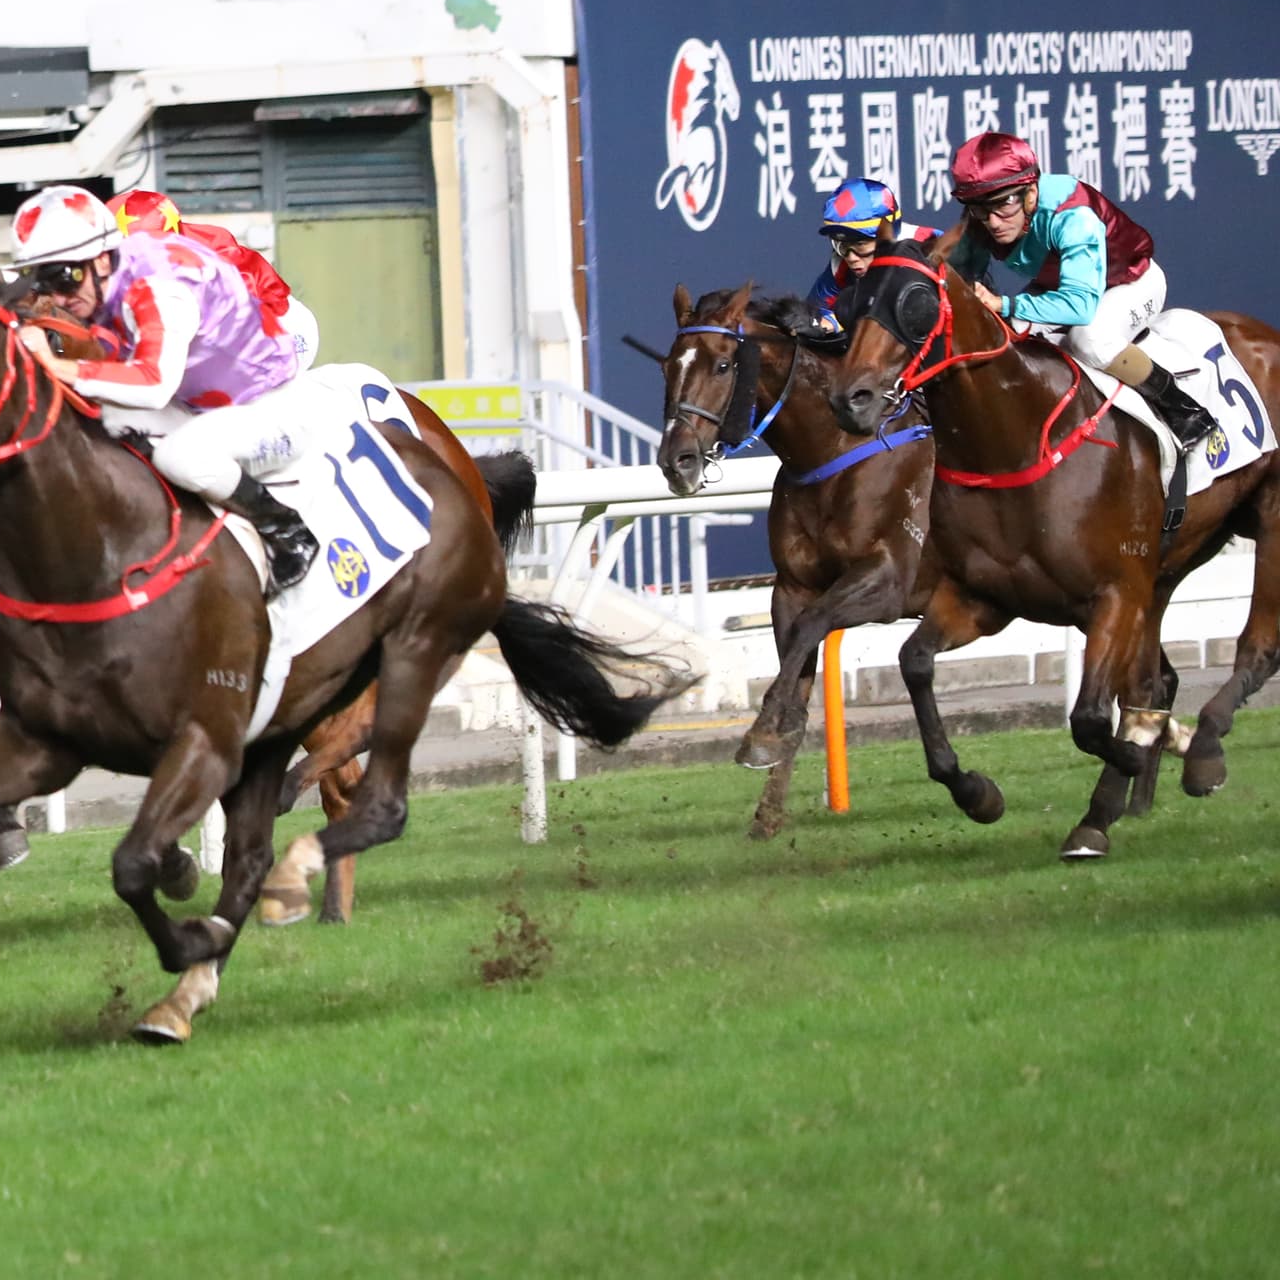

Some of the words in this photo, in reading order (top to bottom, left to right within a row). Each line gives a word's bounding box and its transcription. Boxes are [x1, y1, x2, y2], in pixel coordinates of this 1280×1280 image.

[750, 36, 843, 82] LONGINES
[845, 33, 981, 80] INTERNATIONAL
[983, 31, 1064, 76] JOCKEYS'
[1068, 30, 1193, 74] CHAMPIONSHIP
[1204, 342, 1264, 450] 5
[325, 421, 432, 562] 11
